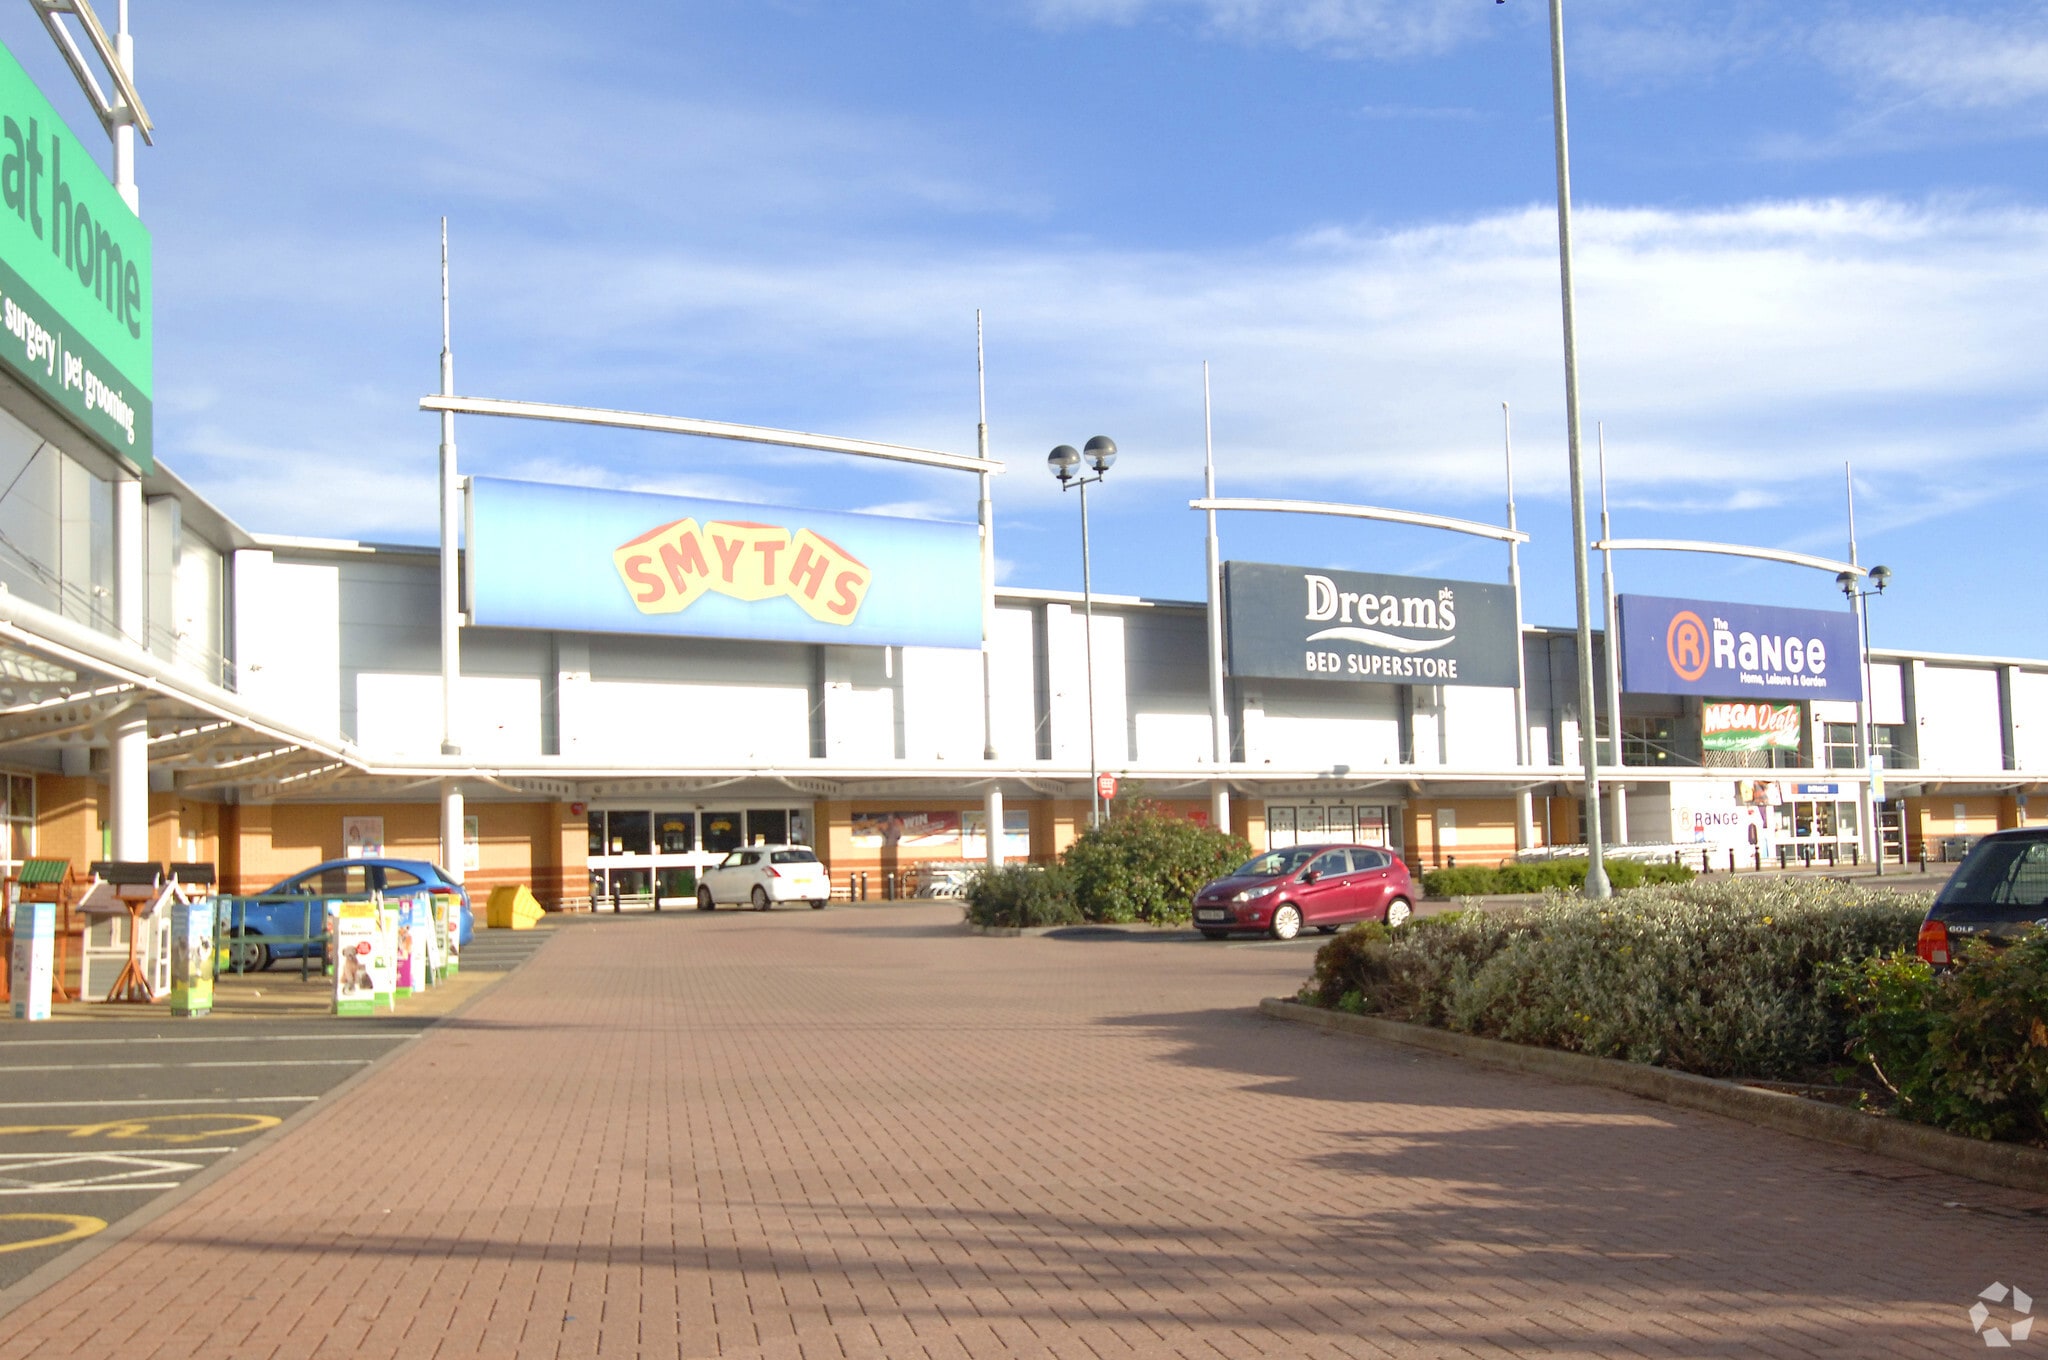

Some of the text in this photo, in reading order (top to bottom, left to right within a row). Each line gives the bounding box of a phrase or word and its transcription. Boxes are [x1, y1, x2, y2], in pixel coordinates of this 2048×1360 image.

[2, 115, 141, 340] at home
[5, 297, 56, 377] surgery
[64, 350, 84, 391] pet
[85, 369, 135, 445] grooming
[624, 530, 864, 616] SMYTHS
[1304, 574, 1457, 631] Dreams
[1438, 586, 1454, 601] plc
[1713, 617, 1729, 630] The
[1305, 651, 1458, 679] BED SUPERSTORE
[1740, 671, 1765, 686] Home,
[1766, 673, 1792, 686] Leisure
[1800, 675, 1827, 688] Garden
[1705, 704, 1798, 733] MEGA Deals
[903, 813, 928, 830] WIN
[1949, 925, 1974, 934] GOLF
